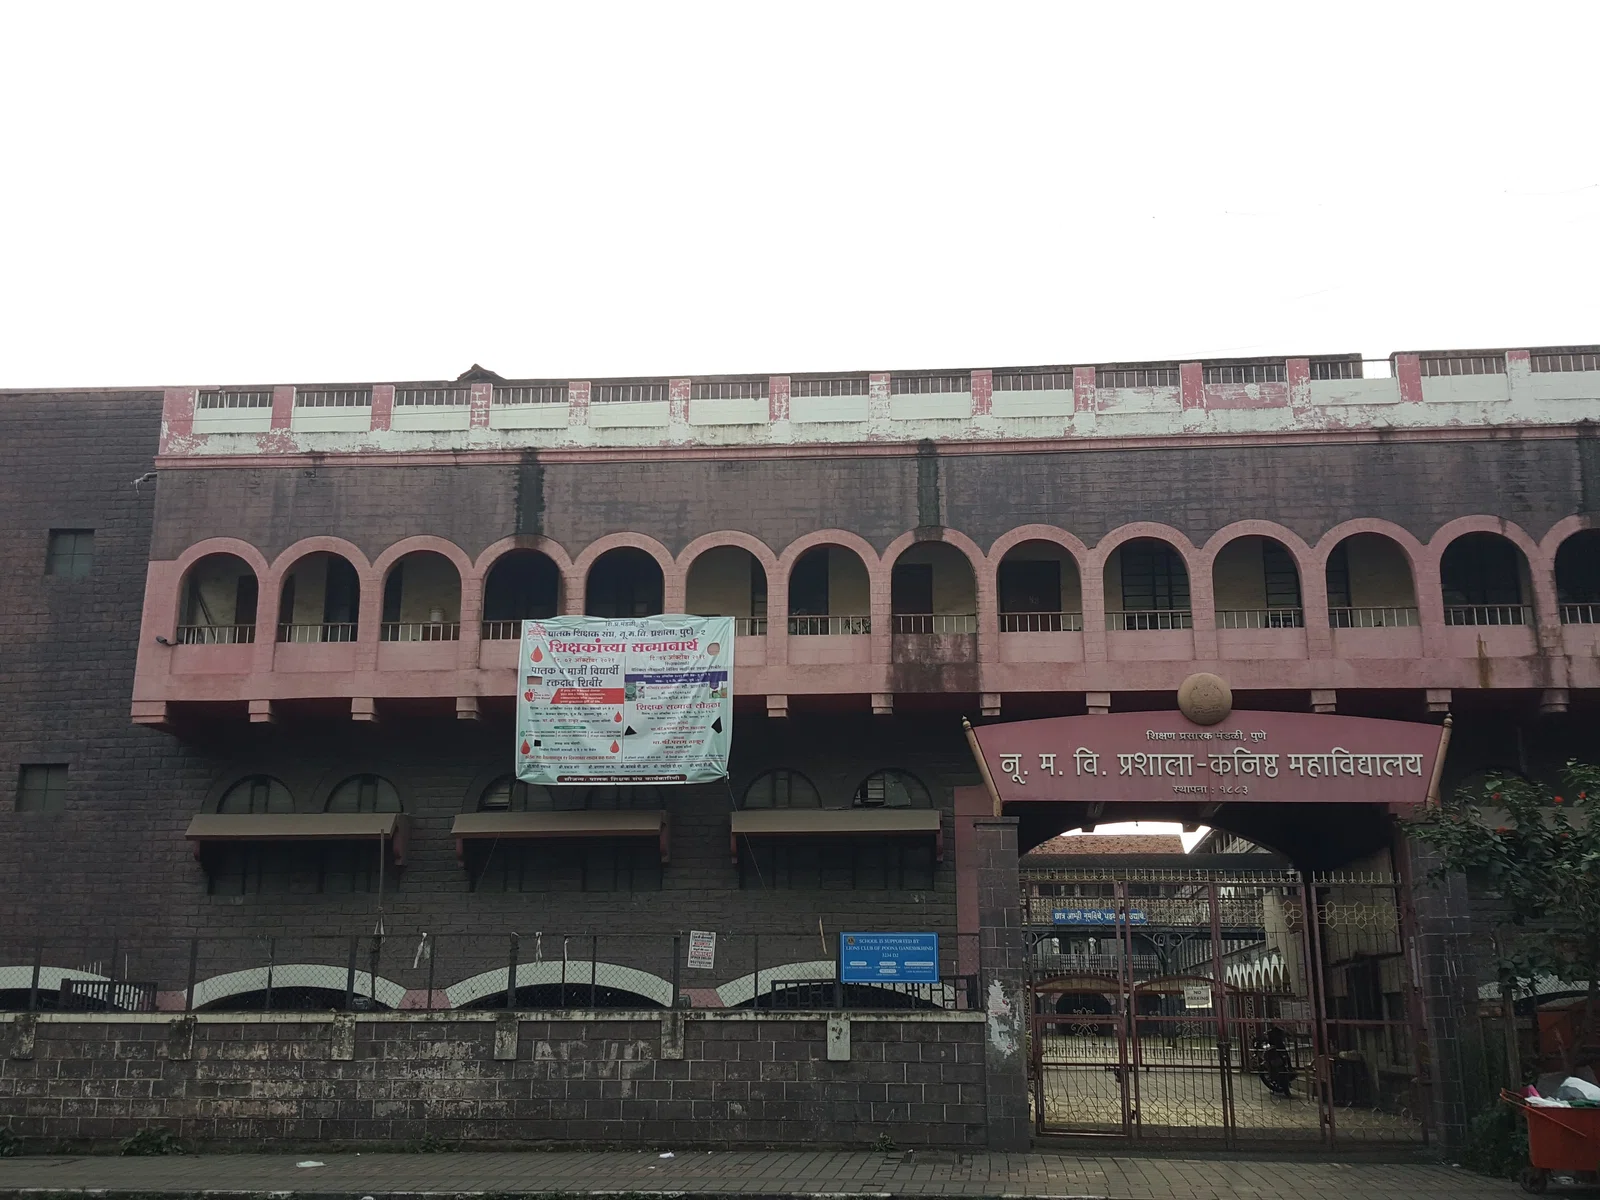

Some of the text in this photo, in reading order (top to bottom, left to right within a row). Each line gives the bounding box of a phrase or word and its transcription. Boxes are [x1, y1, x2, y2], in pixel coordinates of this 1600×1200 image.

[573, 628, 599, 637] शिक्षक
[680, 627, 693, 638] पुणे
[549, 637, 699, 654] शिक्षकांच्या सन्मानार्थ
[531, 666, 556, 675] पालक
[567, 664, 588, 675] माजी
[590, 664, 620, 675] विद्यार्थी
[546, 676, 603, 687] रक्तदान शिबीर
[1145, 729, 1267, 742] शिक्षण प्रसारक मंडळी, पुणे
[999, 753, 1029, 784] नू.
[1038, 753, 1064, 776] म.
[1073, 747, 1107, 776] वि.
[1287, 746, 1424, 777] महाविद्यालय
[1172, 785, 1208, 794] स्थापना
[1219, 784, 1249, 794] १८८३
